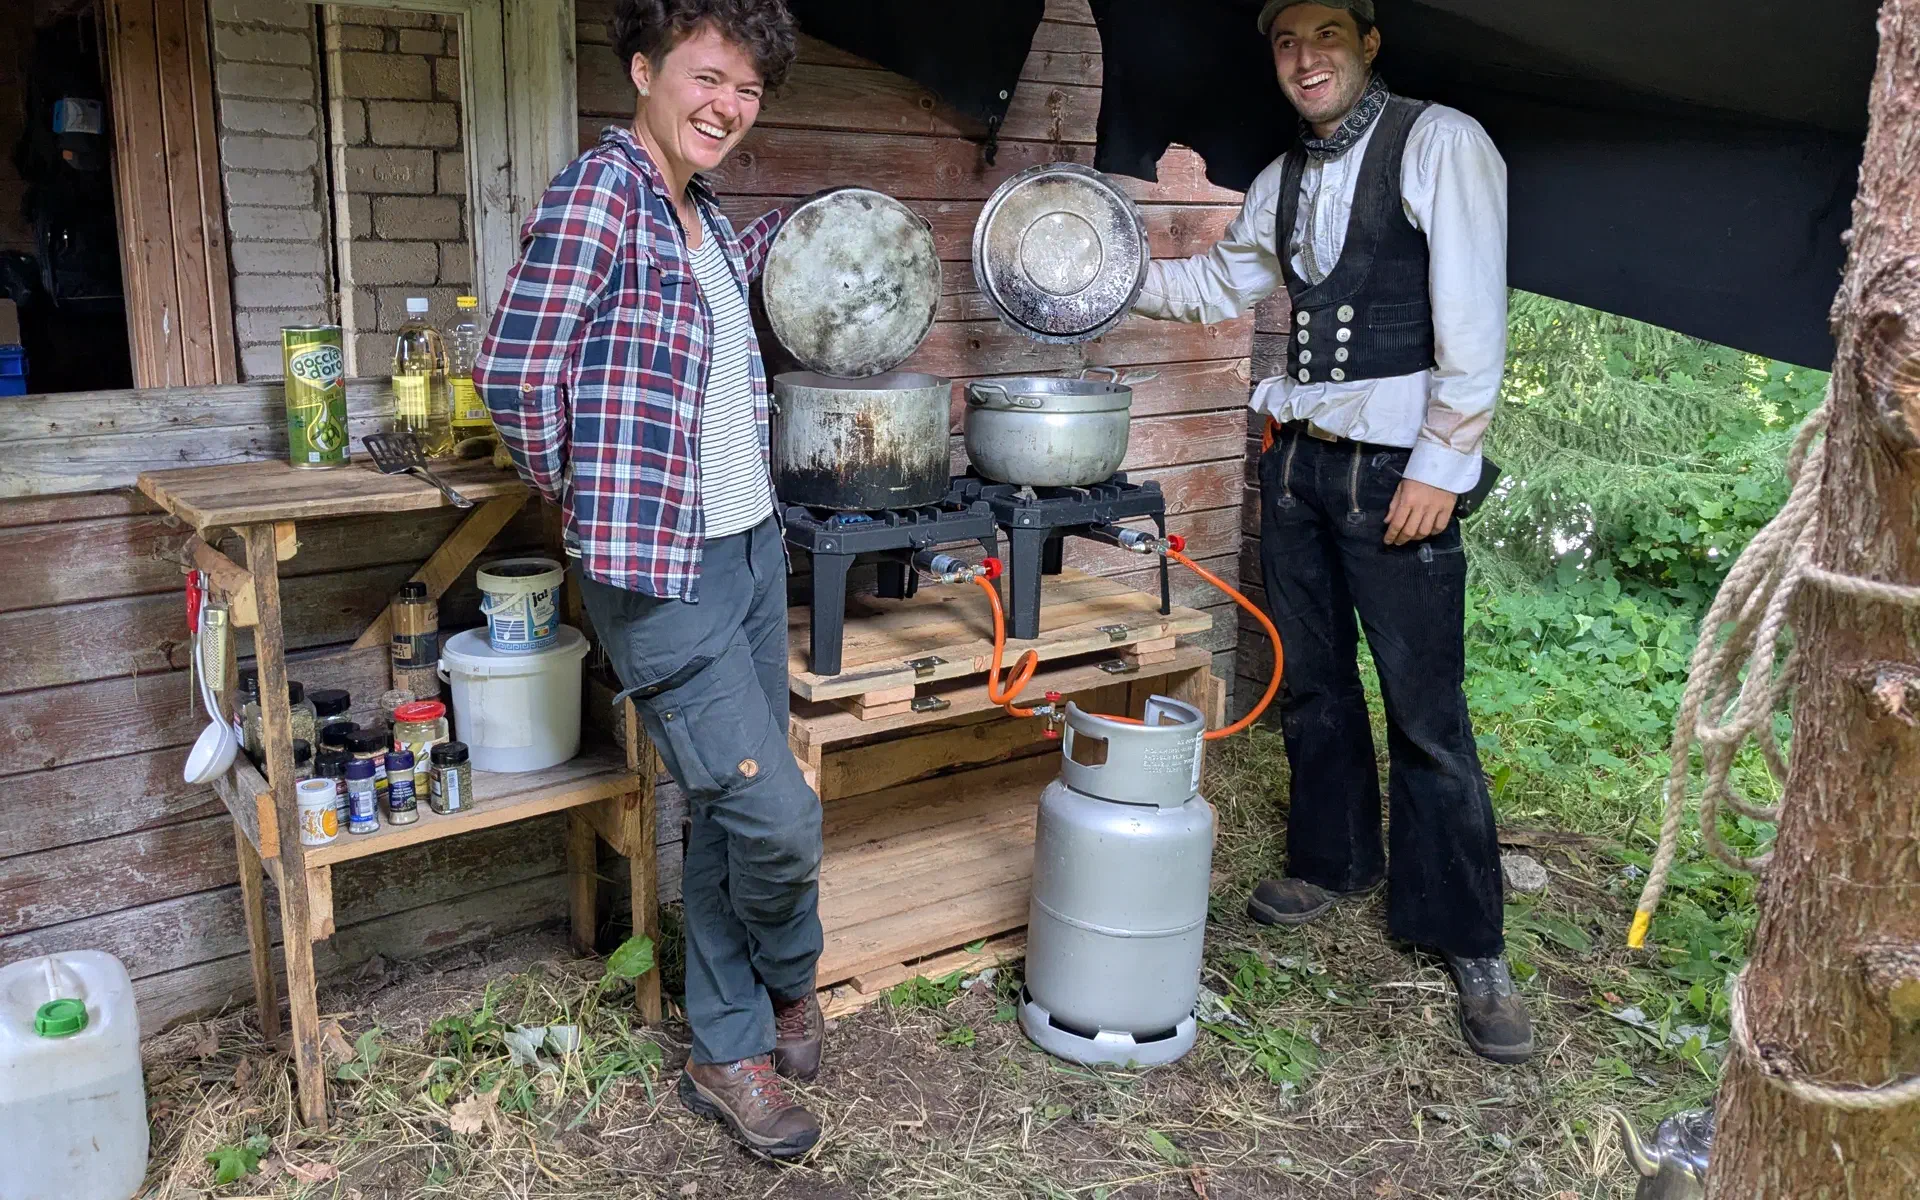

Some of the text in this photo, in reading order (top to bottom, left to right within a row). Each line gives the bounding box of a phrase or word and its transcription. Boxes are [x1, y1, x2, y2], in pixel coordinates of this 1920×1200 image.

[294, 348, 340, 377] goccia
[310, 360, 343, 379] d'oro
[531, 588, 549, 608] ja!
